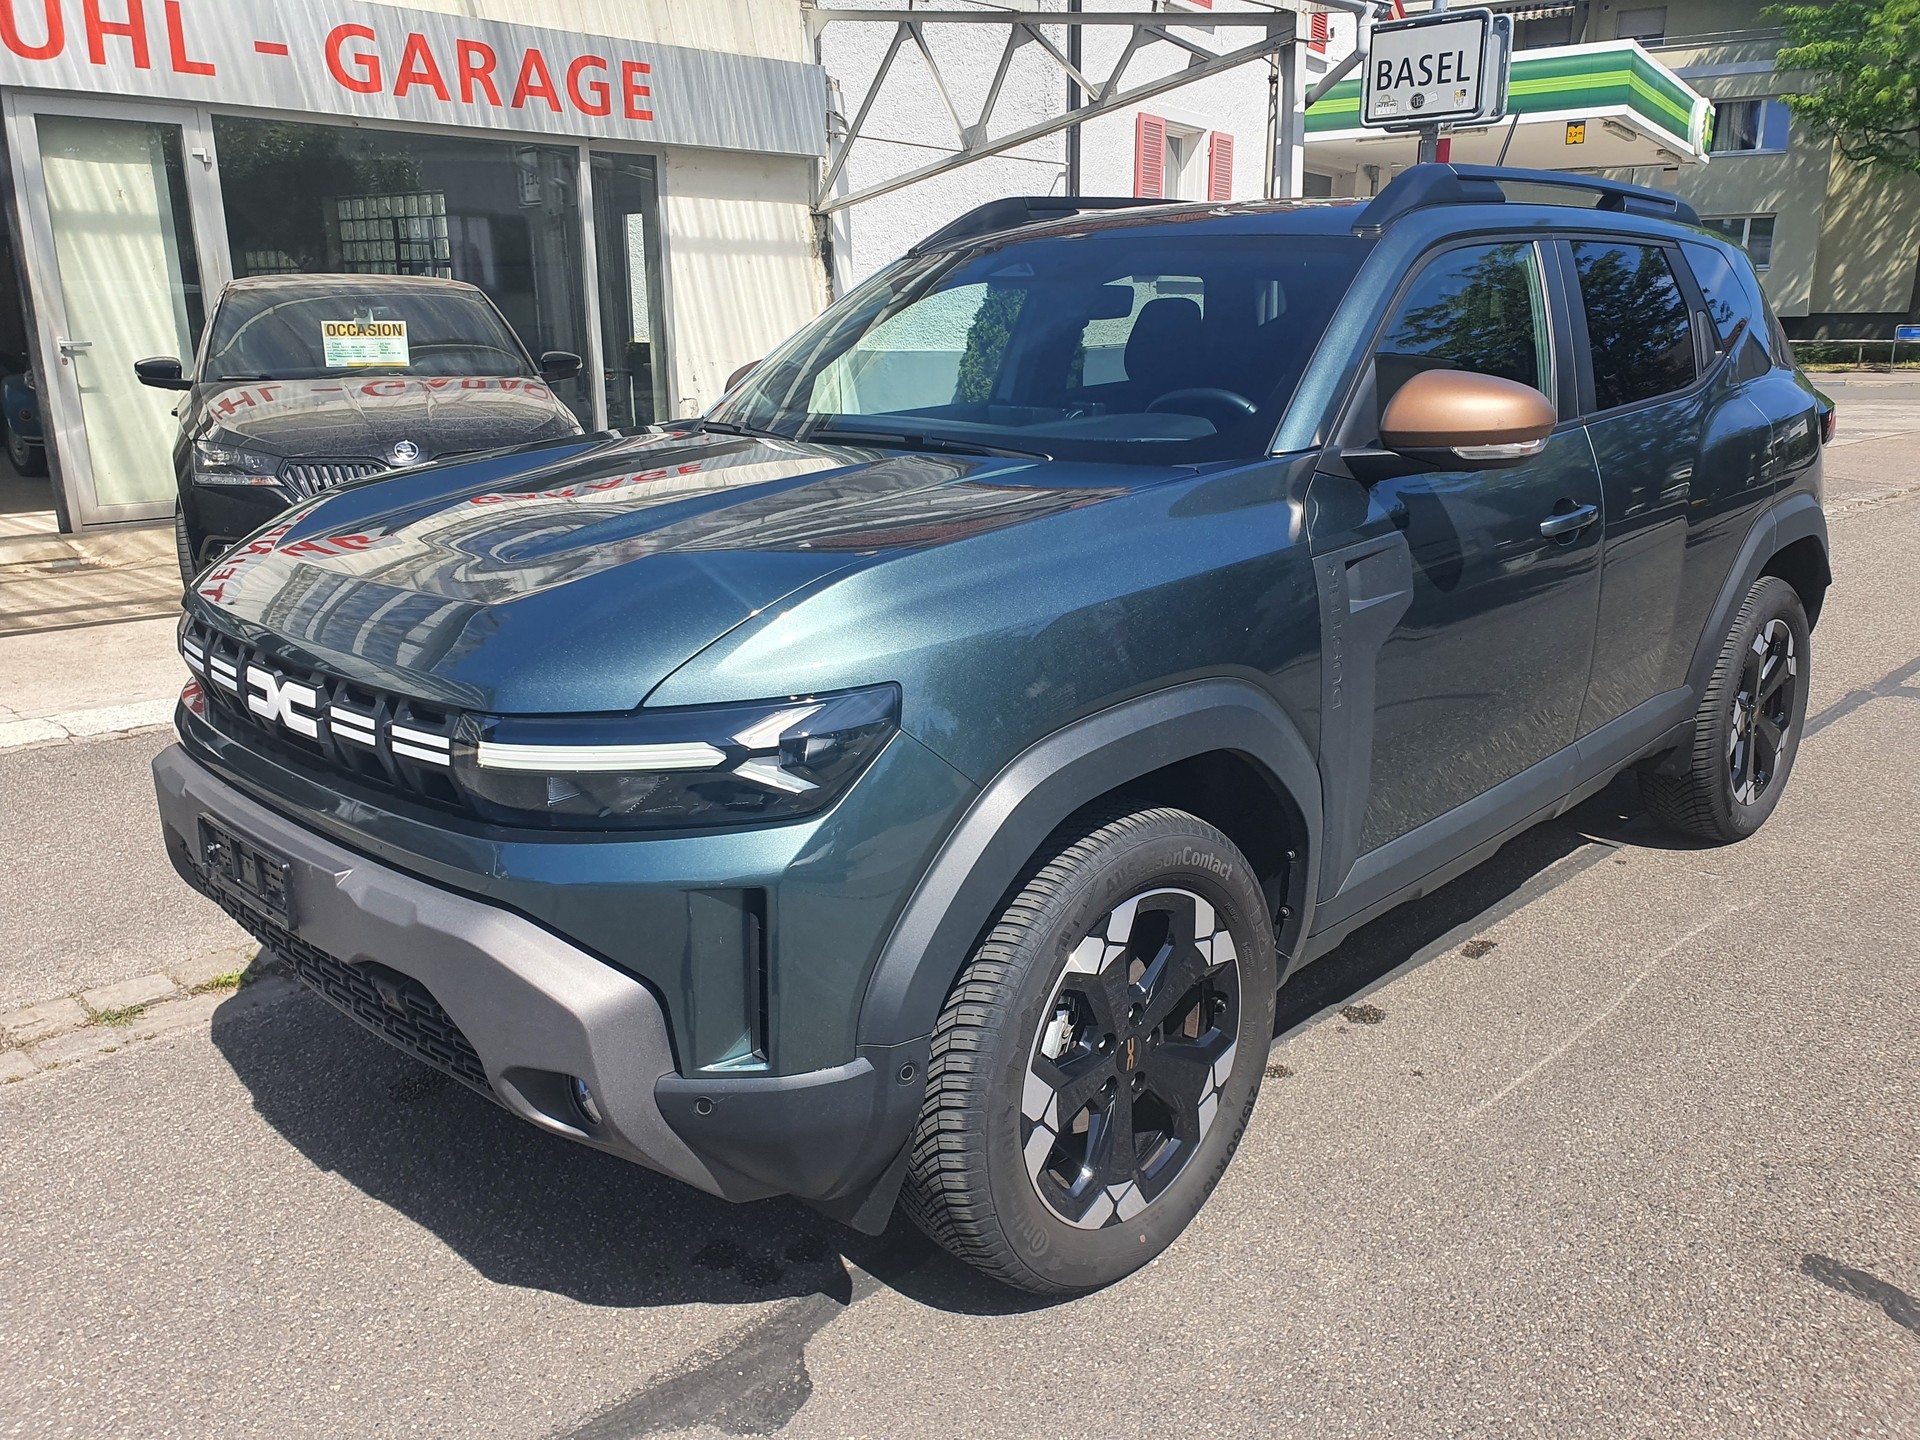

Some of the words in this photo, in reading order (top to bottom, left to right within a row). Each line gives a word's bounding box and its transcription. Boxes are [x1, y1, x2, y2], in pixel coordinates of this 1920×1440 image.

[324, 23, 654, 122] GARAGE
[1376, 50, 1471, 91] BASEL
[326, 323, 402, 337] OCCASION
